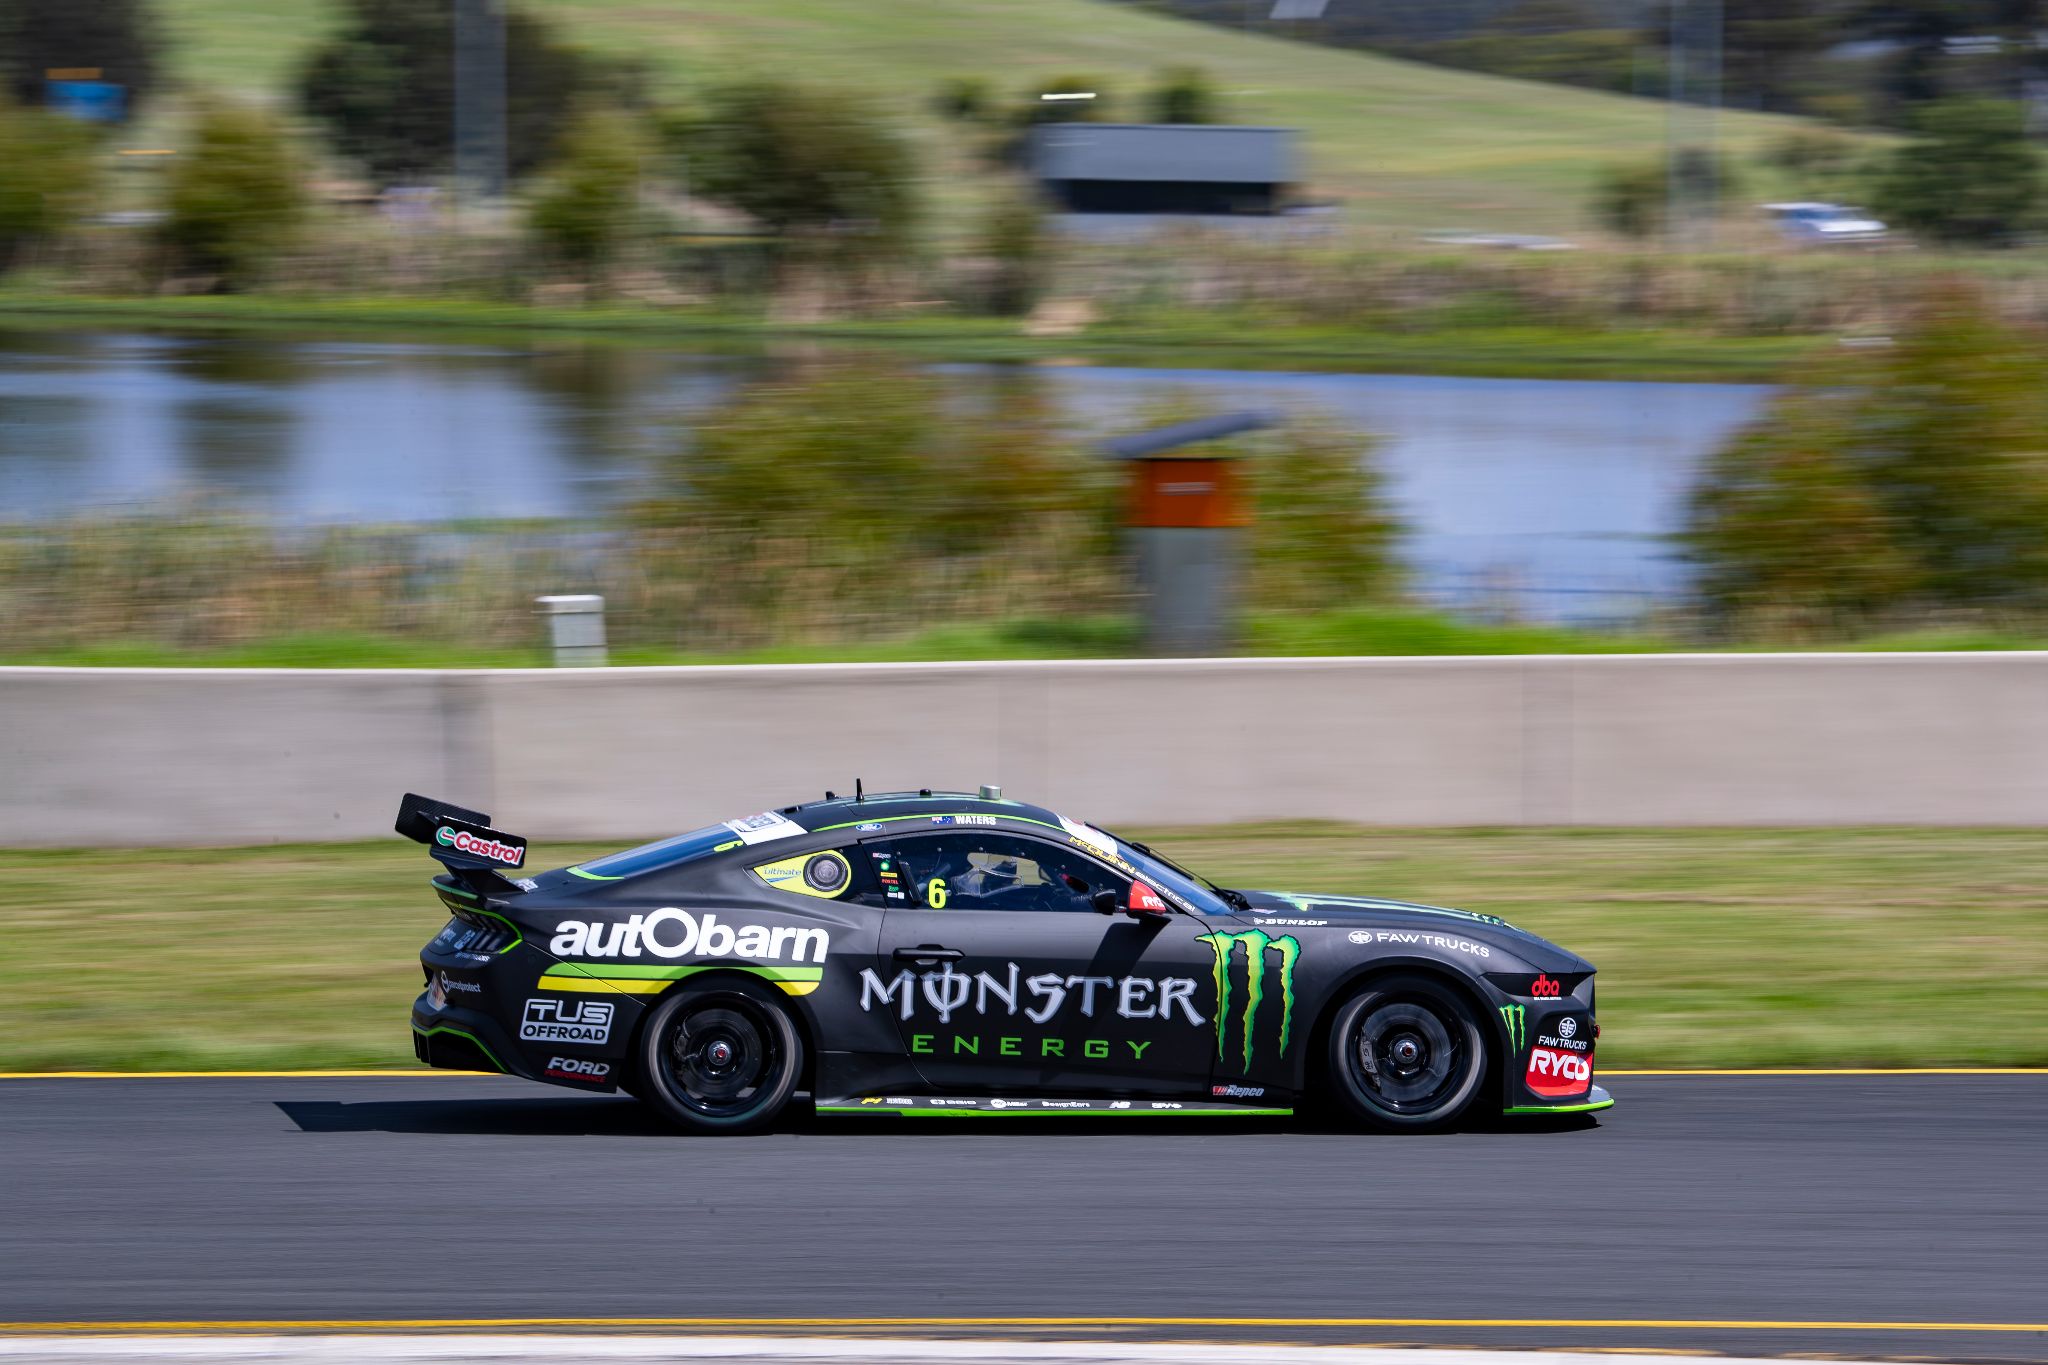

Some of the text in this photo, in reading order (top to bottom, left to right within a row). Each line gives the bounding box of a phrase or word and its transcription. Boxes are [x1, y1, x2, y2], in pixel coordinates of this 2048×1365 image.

[954, 815, 997, 826] WATERS
[454, 831, 525, 865] Castrol
[928, 878, 947, 909] 6
[1264, 918, 1327, 926] DUNLOP
[1376, 932, 1490, 958] FAW TRUCKS
[858, 961, 1206, 1027] MONSTER
[1531, 974, 1560, 997] dba
[529, 1000, 608, 1025] TUS
[522, 1025, 606, 1042] OFFROAD
[1538, 1035, 1588, 1051] FAW TRUCKS
[912, 1033, 1152, 1060] ENERGY
[547, 1056, 610, 1076] FORD
[1529, 1048, 1590, 1081] RYCO
[1227, 1084, 1265, 1098] Repco
